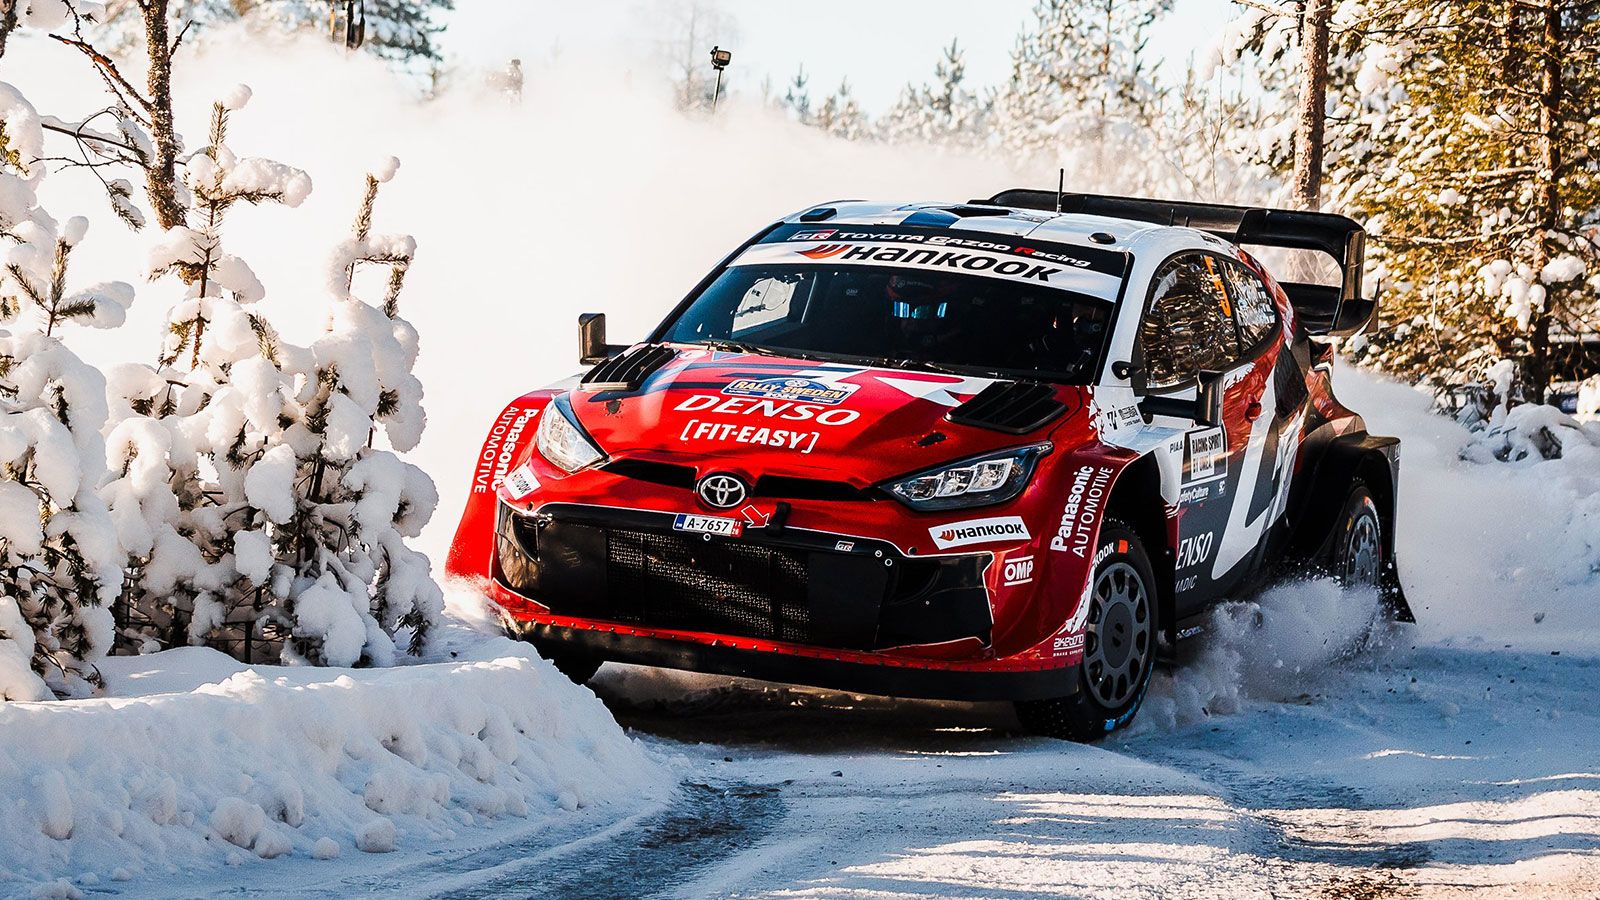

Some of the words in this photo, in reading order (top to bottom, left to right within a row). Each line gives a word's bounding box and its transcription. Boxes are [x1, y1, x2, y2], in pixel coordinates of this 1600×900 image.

[790, 231, 833, 240] GR
[840, 232, 924, 241] TOYOTA
[930, 235, 1010, 250] GAZOO
[1012, 246, 1091, 267] Racing
[735, 381, 780, 392] RALLY
[782, 387, 845, 399] SWEDEN
[674, 394, 861, 426] DENSO
[474, 406, 519, 493] AUTOMOTIVE
[491, 408, 540, 492] Panasonic
[1170, 441, 1183, 453] PIAA
[687, 518, 730, 531] A-7657
[1050, 465, 1095, 552] Panasonic
[1072, 466, 1113, 558] AUTOMOTIVE
[1092, 542, 1114, 568] KOOK
[1175, 531, 1213, 570] ENSO
[1004, 559, 1034, 581] OMP
